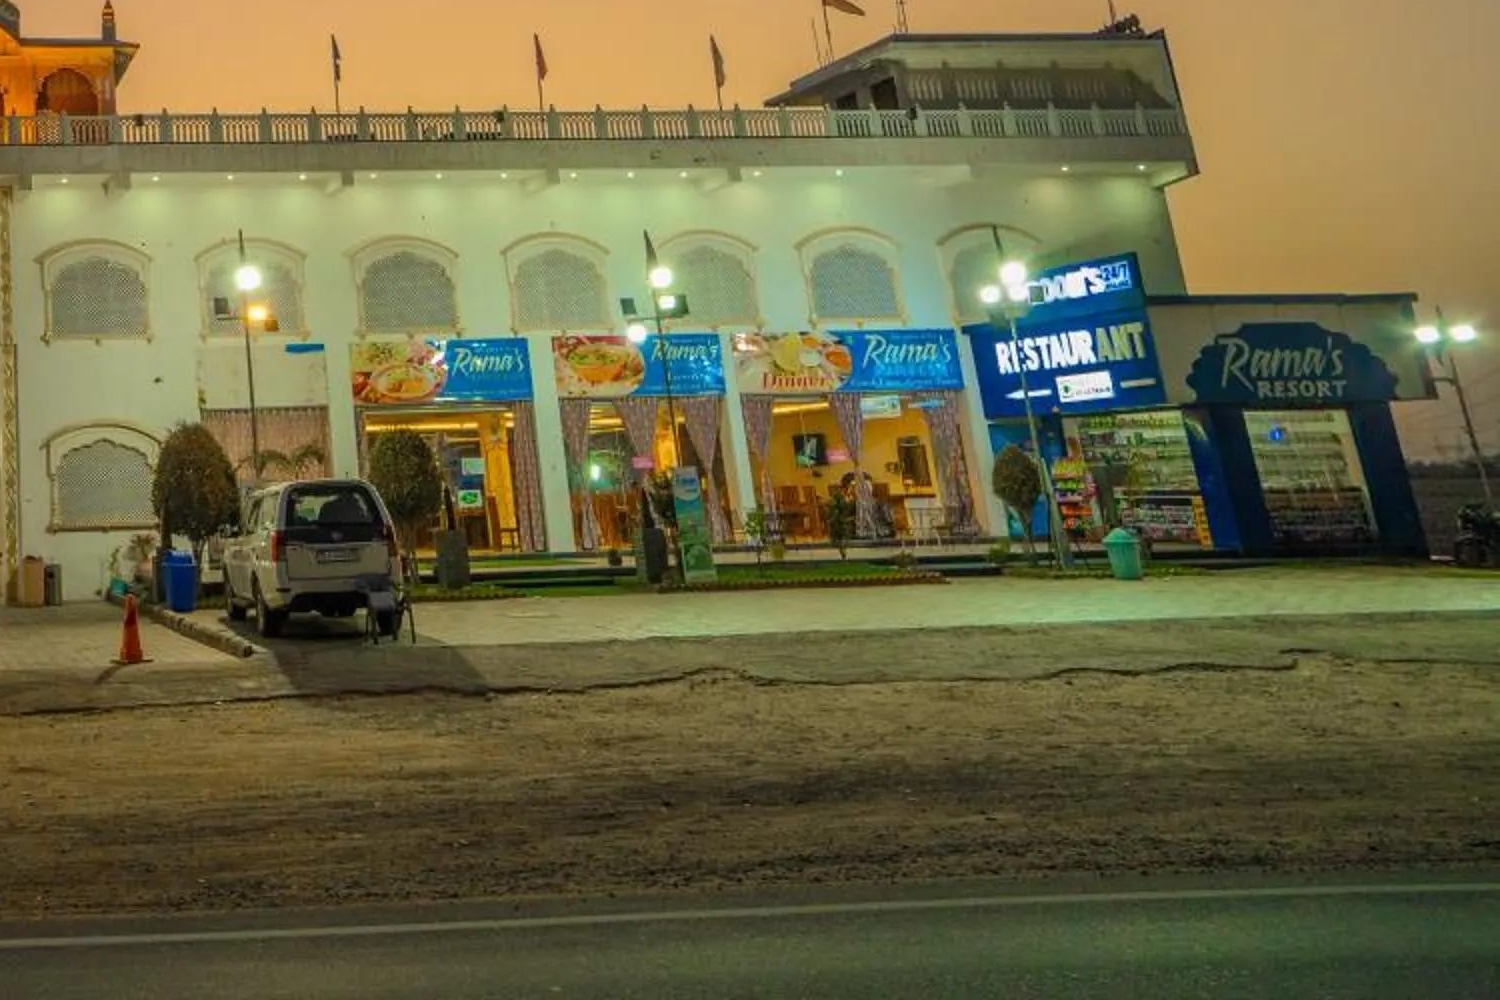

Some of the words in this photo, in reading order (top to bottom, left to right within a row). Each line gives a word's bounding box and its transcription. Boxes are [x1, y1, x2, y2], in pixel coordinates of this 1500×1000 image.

[451, 347, 525, 376] Rama's
[651, 338, 719, 361] Rama's
[862, 334, 951, 368] Rama's
[995, 322, 1146, 375] RESTAURANT
[1216, 336, 1344, 393] Rama's
[1257, 380, 1348, 398] RESORT
